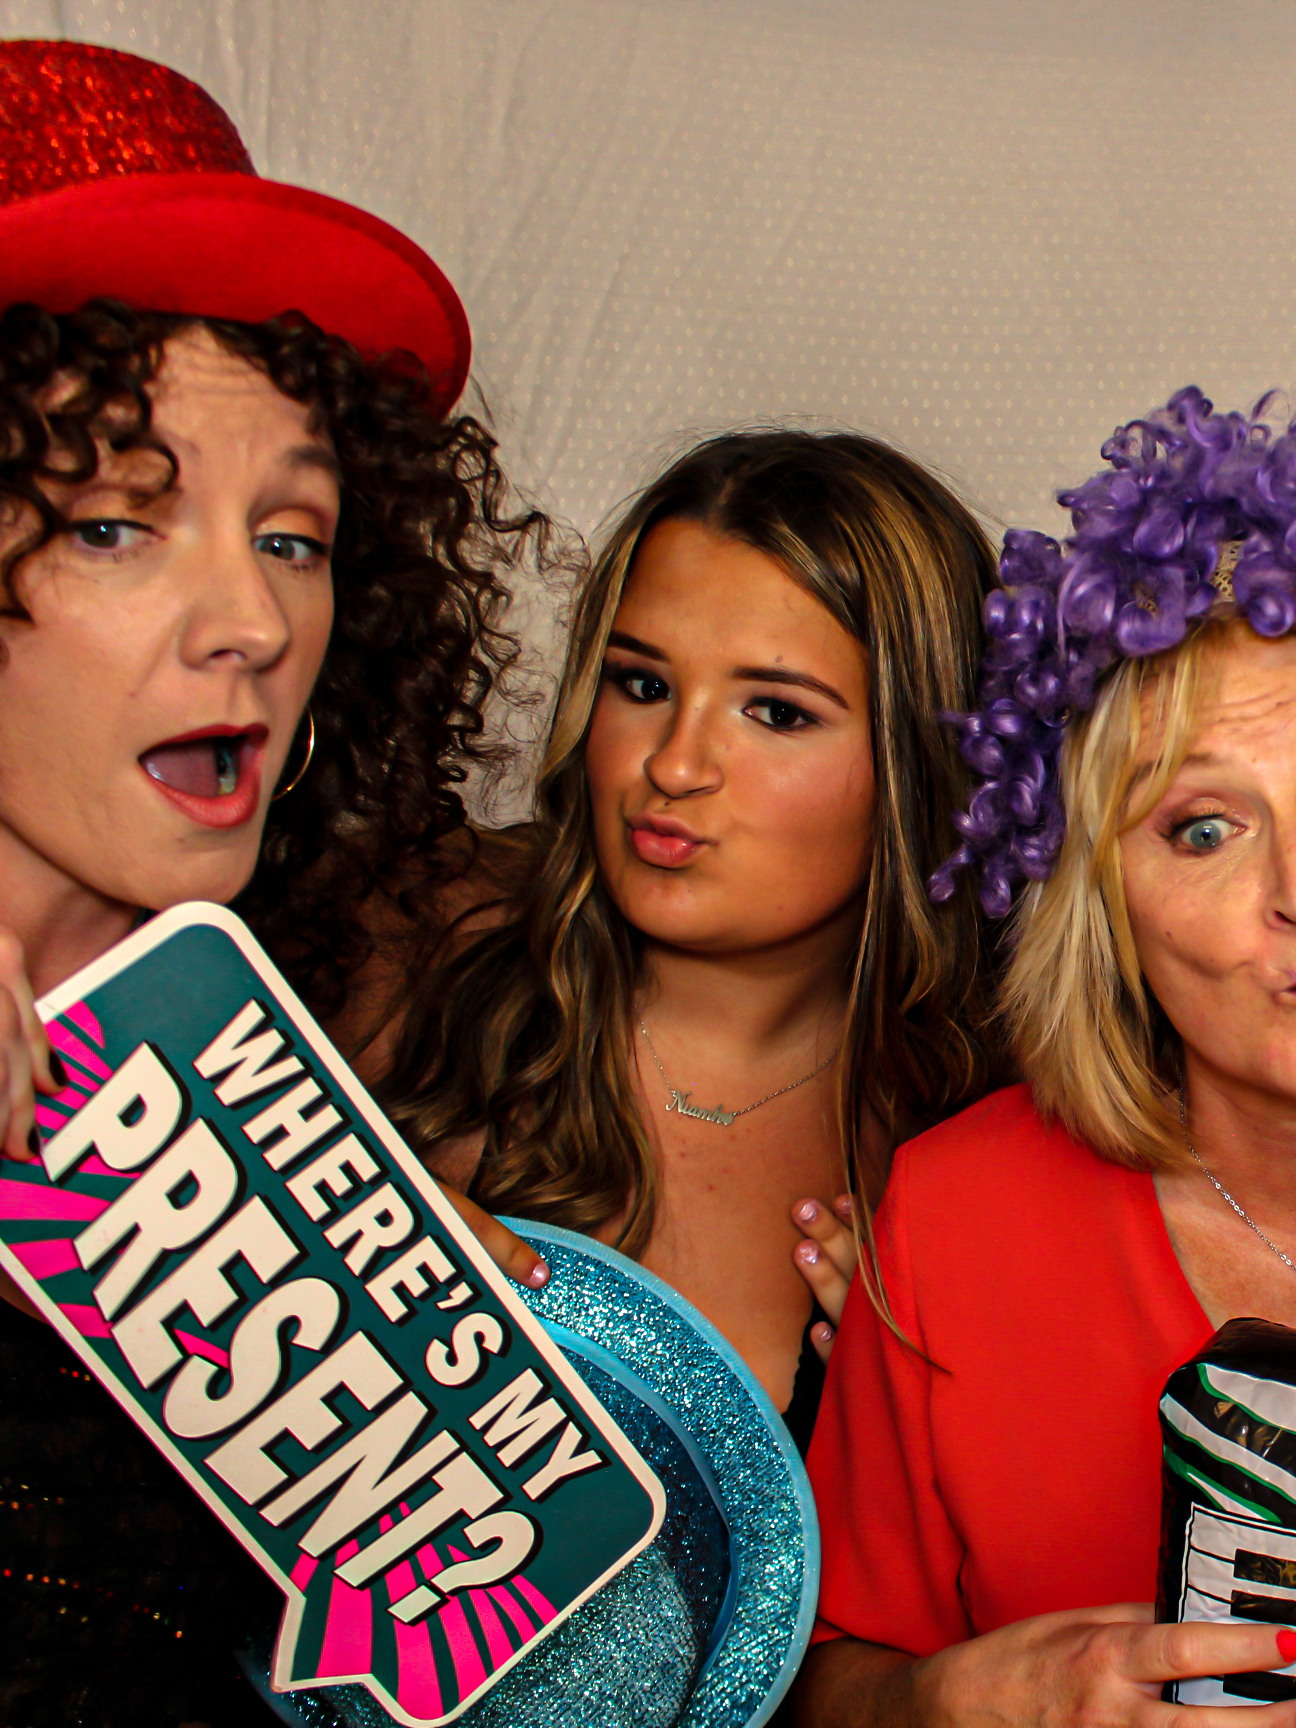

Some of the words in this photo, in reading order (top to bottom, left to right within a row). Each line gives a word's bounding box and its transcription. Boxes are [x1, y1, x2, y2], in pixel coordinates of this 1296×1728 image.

[42, 1042, 538, 1625] PRESENT?
[193, 998, 504, 1388] WHERE'S
[469, 1368, 603, 1502] MY
[665, 1090, 727, 1124] Niamh
